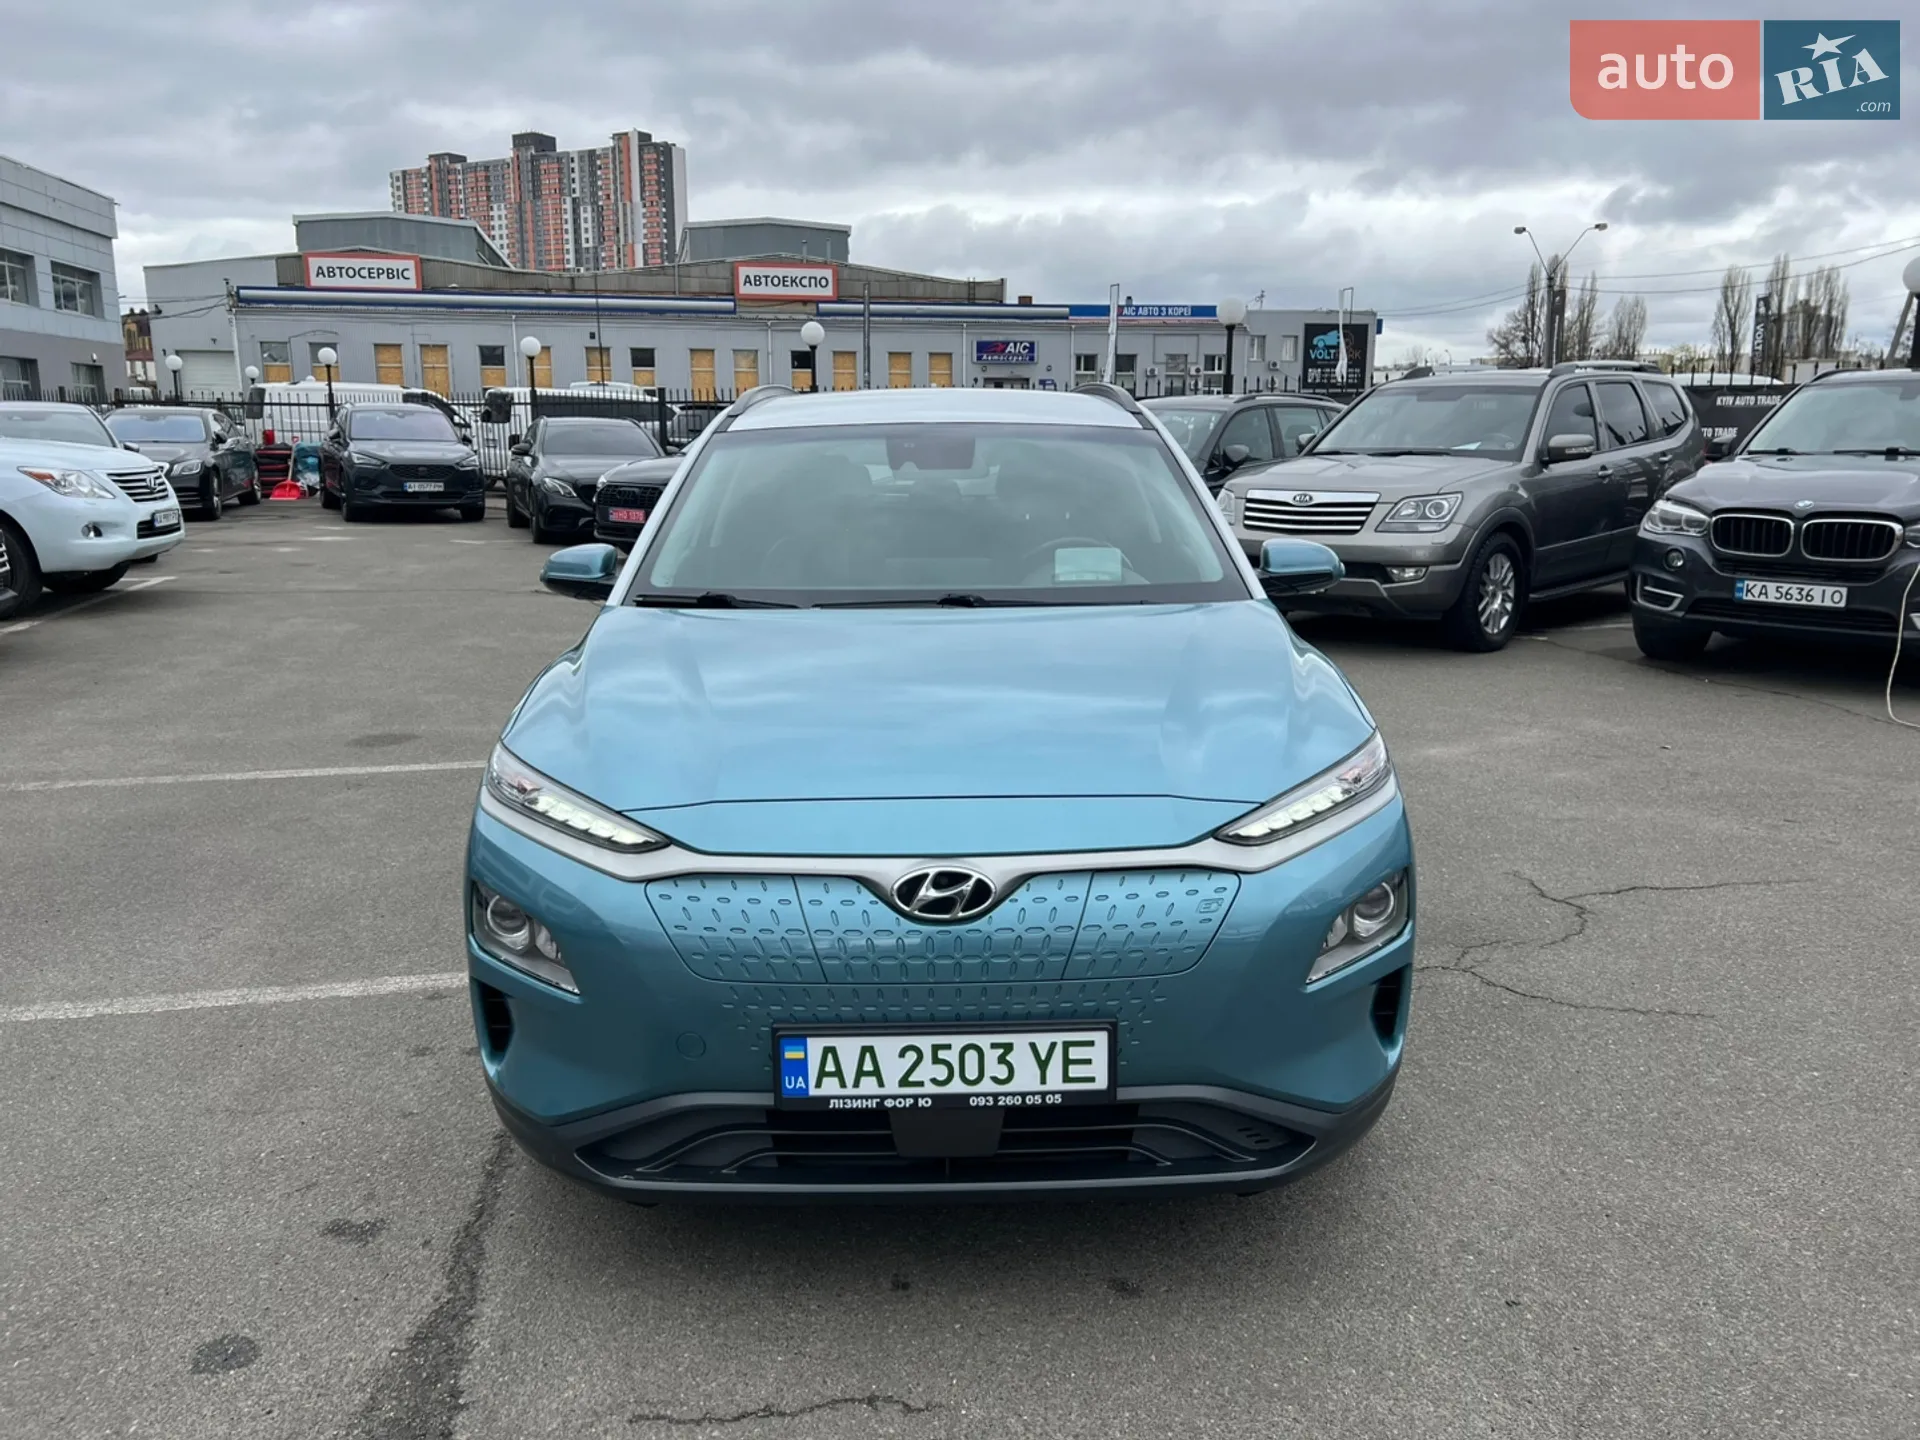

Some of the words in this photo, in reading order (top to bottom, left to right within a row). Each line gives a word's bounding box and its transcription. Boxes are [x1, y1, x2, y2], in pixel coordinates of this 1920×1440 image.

[315, 265, 411, 280] АВТОСЕРВІС
[743, 274, 829, 289] АВТОЕКСПО
[1138, 306, 1159, 316] АВТО
[1309, 348, 1362, 360] VOLTRK
[1716, 396, 1734, 406] KYIV
[1734, 395, 1756, 406] AUTO
[1757, 394, 1782, 405] TRADE
[1701, 427, 1712, 437] TO
[1714, 427, 1738, 437] TRADE
[1745, 584, 1768, 599] KA
[1774, 586, 1814, 602] 5636
[815, 1045, 885, 1089] AA
[898, 1042, 1015, 1088] 2503
[1028, 1040, 1096, 1085] YE
[785, 1076, 806, 1089] UA
[829, 1099, 880, 1109] ЛІЗИНГ
[884, 1098, 914, 1108] ФОР
[918, 1097, 932, 1107] Ю
[969, 1096, 994, 1106] 093
[997, 1095, 1022, 1106] 260
[1025, 1095, 1042, 1105] 05
[1045, 1094, 1062, 1104] 05
